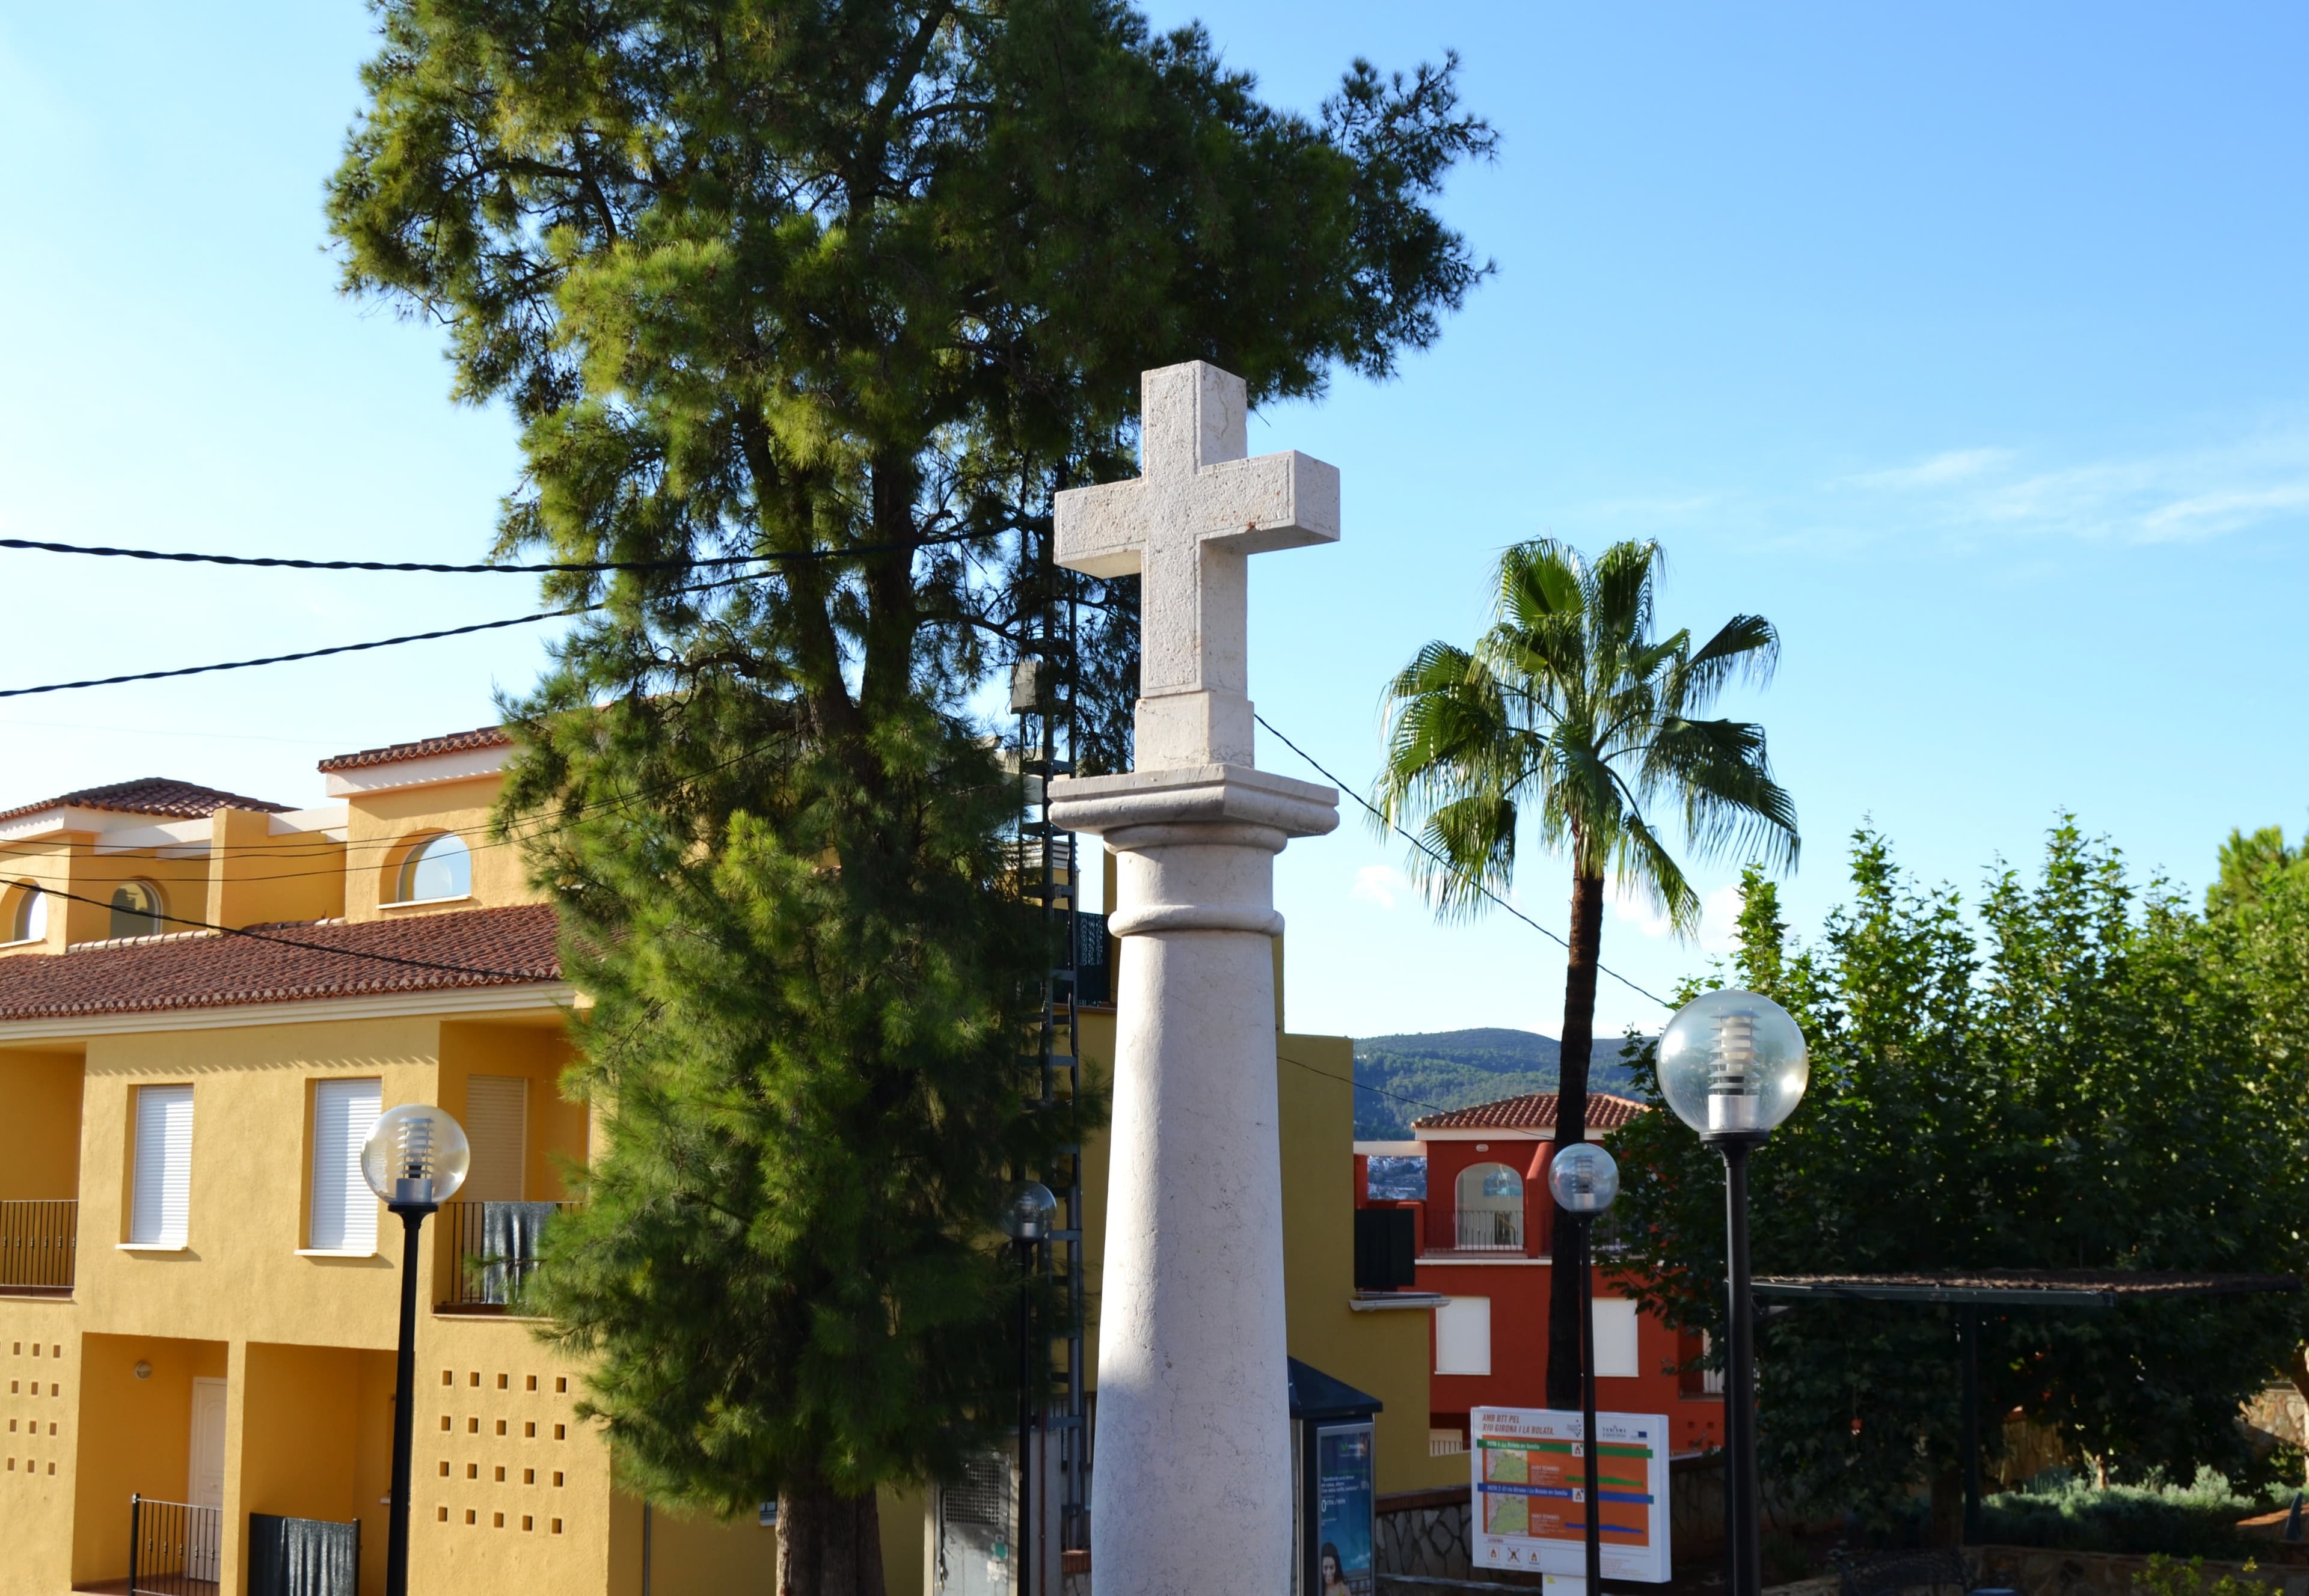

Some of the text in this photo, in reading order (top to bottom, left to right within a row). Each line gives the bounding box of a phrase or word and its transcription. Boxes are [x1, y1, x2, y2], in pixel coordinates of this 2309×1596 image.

[1482, 1414, 1519, 1423] AMB BTT PEL
[1482, 1423, 1494, 1432] RIU
[1495, 1424, 1517, 1433] GIRONA
[1532, 1426, 1554, 1435] BOLATA
